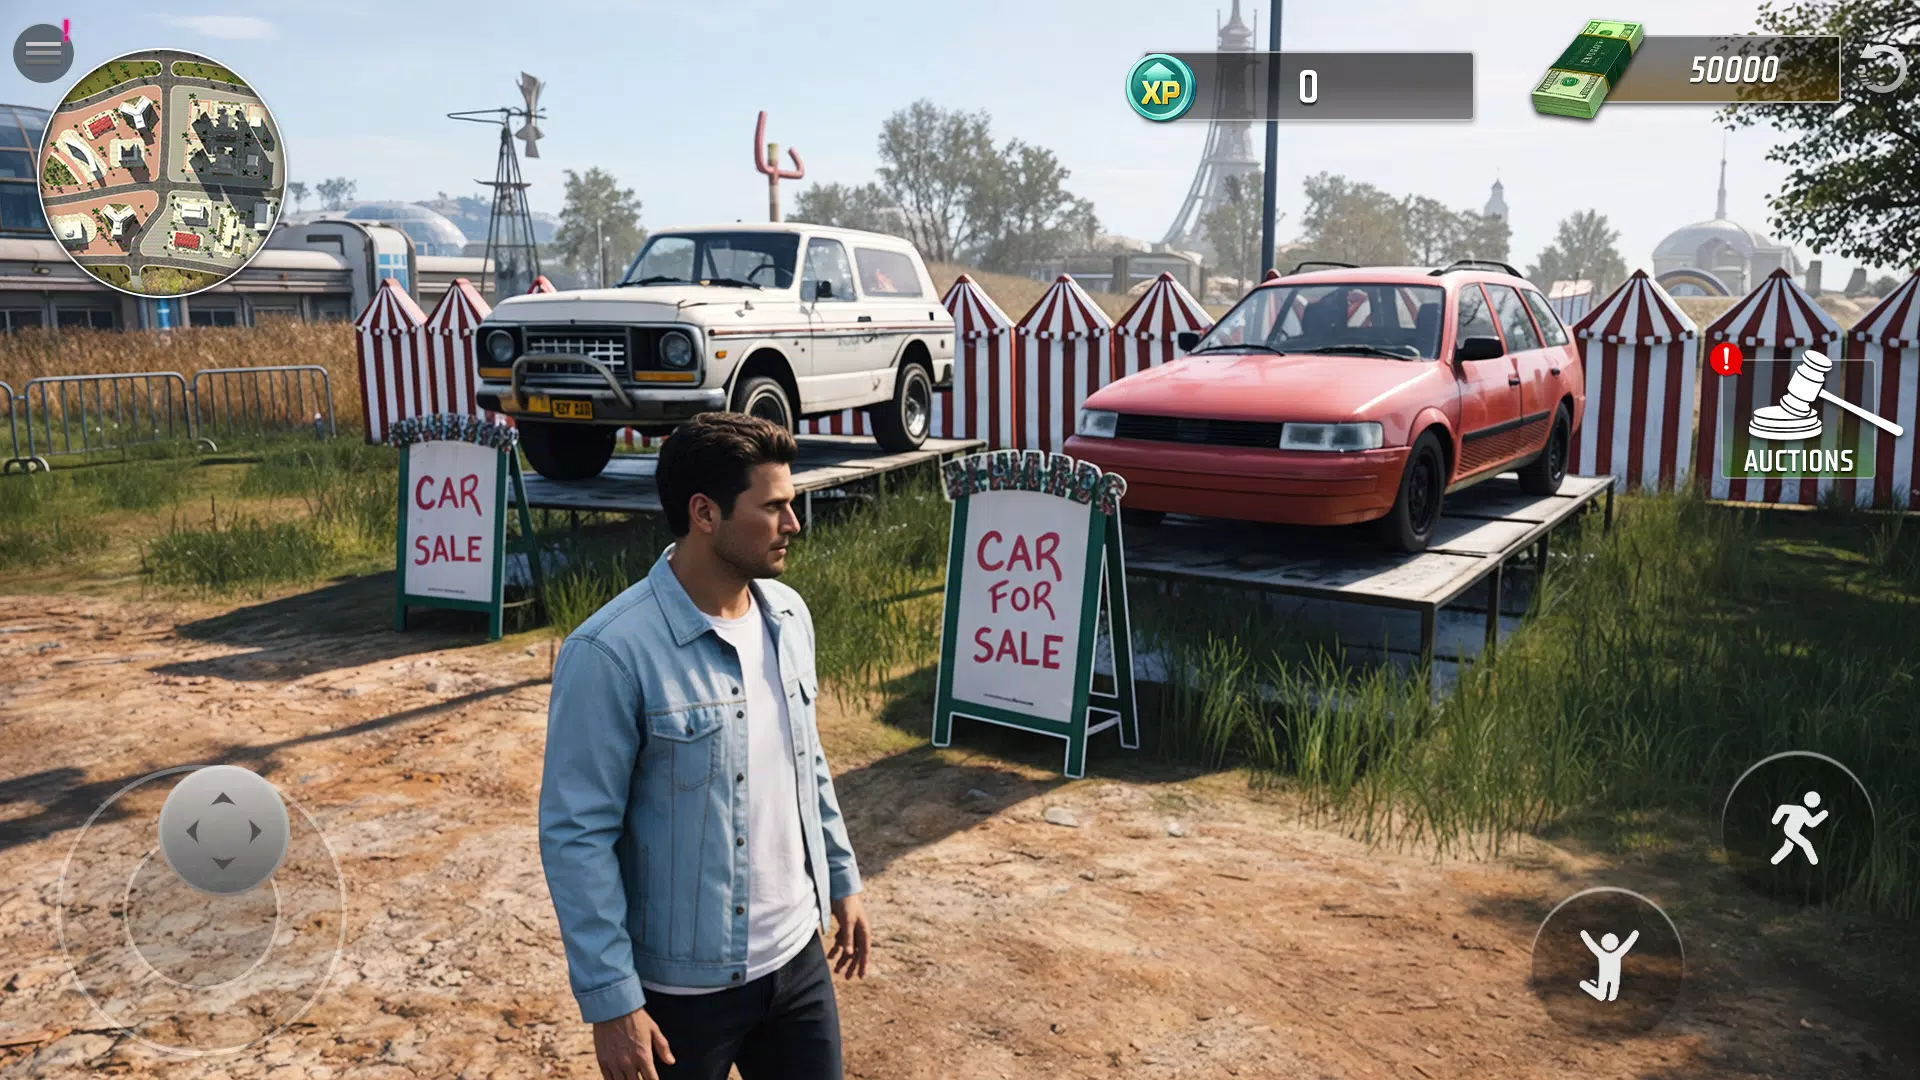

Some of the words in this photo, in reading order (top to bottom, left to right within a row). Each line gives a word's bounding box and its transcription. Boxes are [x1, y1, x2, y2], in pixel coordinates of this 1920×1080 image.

[415, 474, 482, 517] CAR
[414, 534, 483, 566] SALE
[977, 530, 1063, 582] CAR
[988, 579, 1056, 621] FOR
[973, 626, 1064, 670] SALE
